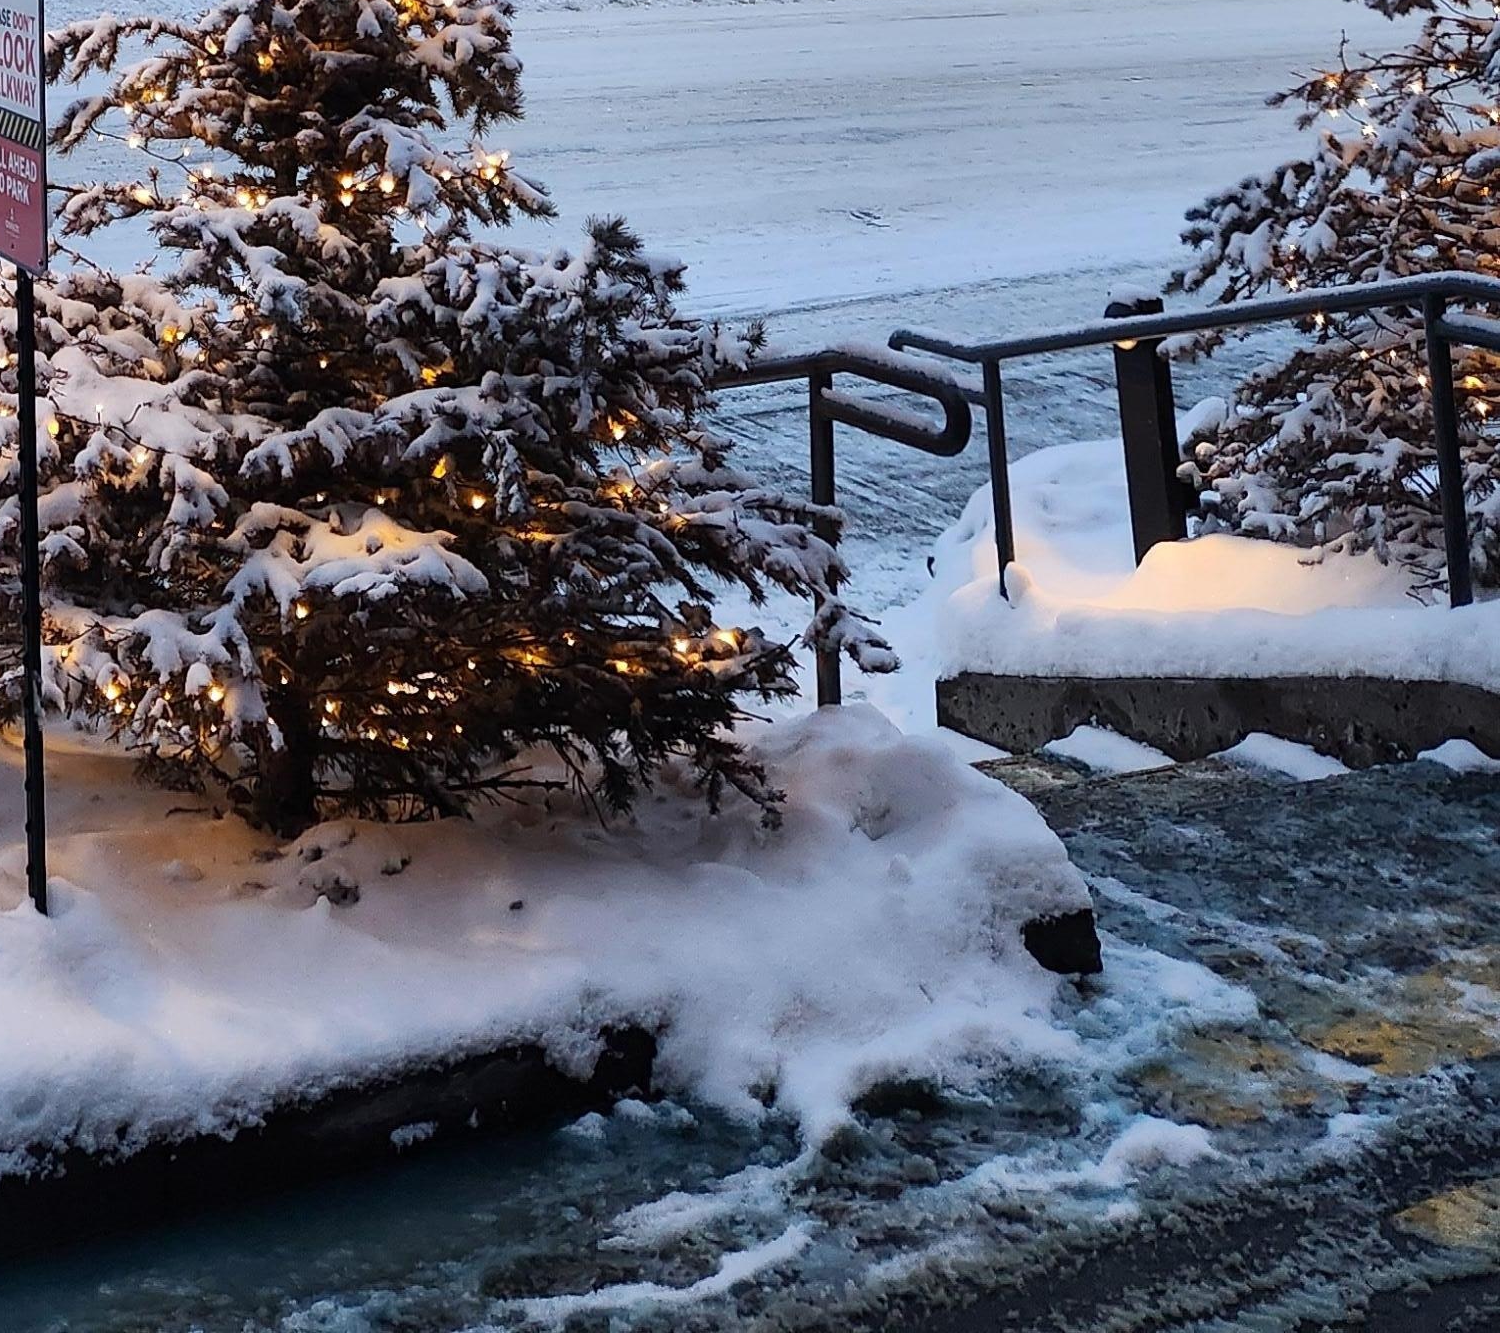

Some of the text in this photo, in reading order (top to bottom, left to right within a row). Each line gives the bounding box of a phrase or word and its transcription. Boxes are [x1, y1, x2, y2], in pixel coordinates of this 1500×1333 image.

[12, 11, 36, 35] DON'T
[8, 151, 37, 183] AHEAD
[6, 175, 30, 206] PARK
